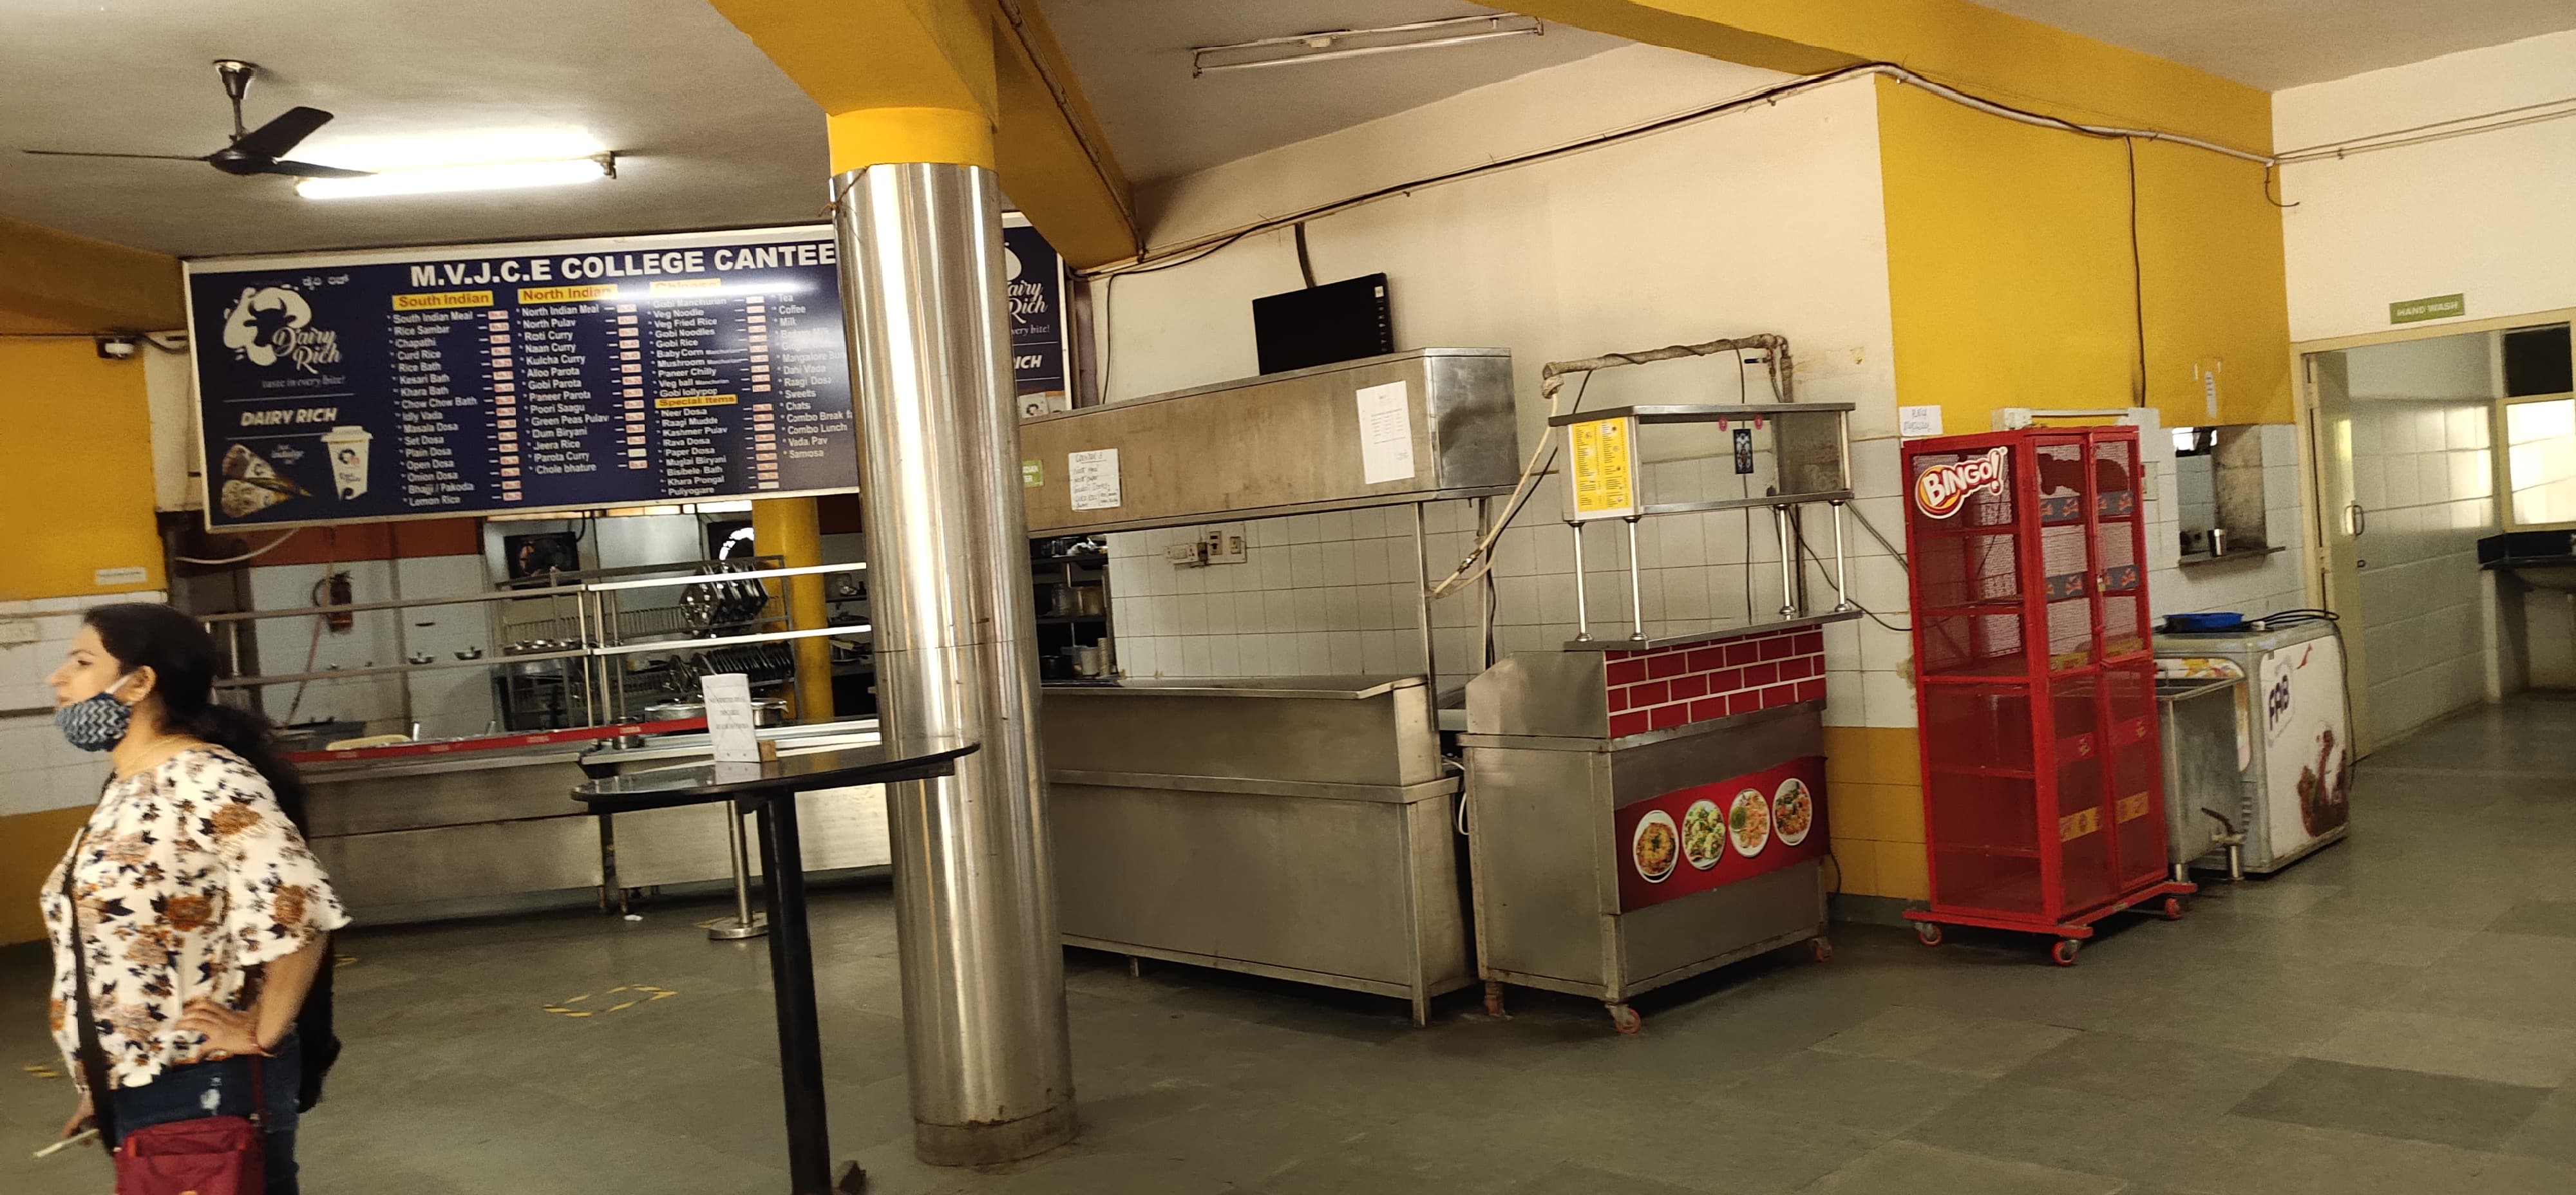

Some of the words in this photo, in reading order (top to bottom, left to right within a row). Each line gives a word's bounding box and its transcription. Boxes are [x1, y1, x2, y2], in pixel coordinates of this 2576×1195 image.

[410, 259, 552, 287] M.V.J.C.E
[561, 250, 705, 279] COLLEGE
[524, 289, 564, 300] North
[569, 287, 611, 298] Indian
[1008, 279, 1043, 301] airy
[399, 296, 440, 307] South
[445, 294, 489, 305] Indian
[778, 294, 793, 302] Tea
[522, 307, 548, 317] North
[549, 306, 578, 315] Indian
[579, 304, 599, 314] Meal
[779, 305, 806, 314] Coffee
[1009, 294, 1048, 323] Rich
[2397, 306, 2425, 316] HAND
[2427, 301, 2458, 312] WASH
[393, 314, 421, 323] South
[422, 313, 449, 322] Indian
[653, 311, 672, 319] Veg
[523, 320, 549, 329] North
[551, 318, 576, 327] Pulav
[654, 321, 672, 329] Veg
[779, 317, 797, 326] Milk
[393, 326, 415, 335] Rice
[417, 325, 450, 334] Sambar
[1011, 328, 1029, 336] very
[524, 332, 545, 341] Roti
[548, 331, 573, 341] Curry
[272, 326, 337, 357] Dairy
[395, 338, 437, 348] Chapathi
[525, 344, 549, 353] Naan
[551, 343, 576, 353] Curry
[292, 343, 343, 374] Rich
[397, 351, 420, 361] Curd
[421, 350, 442, 359] Rice
[656, 350, 680, 359] Baby
[526, 355, 559, 365] Kulcha
[560, 355, 586, 365] Curry
[1014, 355, 1042, 369] ICH
[398, 363, 418, 372] Rice
[421, 362, 442, 372] Bath
[690, 368, 717, 376] Chilly
[783, 365, 801, 374] Dahi
[804, 364, 826, 373] Vada
[551, 368, 580, 377] Parota
[399, 375, 428, 384] Kesari
[430, 374, 450, 383] Bath
[784, 378, 807, 388] Raagi
[528, 381, 551, 390] Gobi
[553, 379, 582, 388] Parota
[401, 388, 427, 397] Khara
[429, 386, 450, 395] Bath
[529, 393, 561, 402] Paneer
[563, 391, 591, 400] Parota
[659, 389, 681, 397] Gobi
[785, 390, 817, 399] Sweets
[402, 400, 427, 409] Chow
[429, 399, 453, 408] Chow
[659, 396, 702, 406] Special
[705, 395, 735, 404] Items
[530, 405, 555, 414] Poori
[557, 403, 585, 413] Saagu
[786, 402, 811, 410] Chats
[241, 409, 294, 426] DAIRY
[295, 408, 337, 424] RICH
[402, 412, 419, 422] Idly
[421, 411, 443, 420] Vada
[661, 409, 681, 417] Neer
[786, 413, 818, 422] Combo
[820, 411, 844, 420] Break
[531, 417, 559, 426] Green
[561, 416, 583, 425] Peas
[585, 414, 609, 423] Pulav
[661, 419, 687, 428] Raagi
[688, 417, 718, 426] Mudde
[403, 424, 435, 433] Masala
[436, 423, 459, 432] Dosa
[532, 429, 554, 438] Dum
[556, 427, 588, 438] Biryani
[705, 427, 728, 435] Pulav
[787, 425, 819, 435] Combo
[820, 422, 848, 432] Lunch
[404, 437, 419, 446] Set
[421, 435, 444, 445] Dosa
[533, 442, 559, 450] Jeera
[561, 440, 581, 448] Rice
[663, 438, 685, 447] Rava
[788, 438, 809, 446] Vada
[811, 437, 828, 445] Pav
[405, 448, 428, 457] Plain
[430, 447, 452, 456] Dosa
[534, 453, 564, 462] Parota
[566, 452, 589, 462] Curry
[665, 448, 690, 457] Paper
[789, 449, 824, 458] Samosa
[406, 461, 431, 471] Open
[432, 460, 455, 469] Dosa
[666, 458, 694, 467] Muglai
[696, 455, 727, 466] Biryani
[535, 466, 562, 474] Chole
[564, 463, 597, 473] bhature
[703, 466, 723, 475] Bath
[408, 473, 435, 482] Onion
[436, 471, 459, 481] Dosa
[667, 478, 692, 486] Khara
[694, 476, 724, 485] Pongal
[1923, 451, 2000, 507] BINGO!
[440, 483, 475, 492] Pakoda
[408, 497, 440, 507] Lemon
[442, 495, 461, 504] Rice
